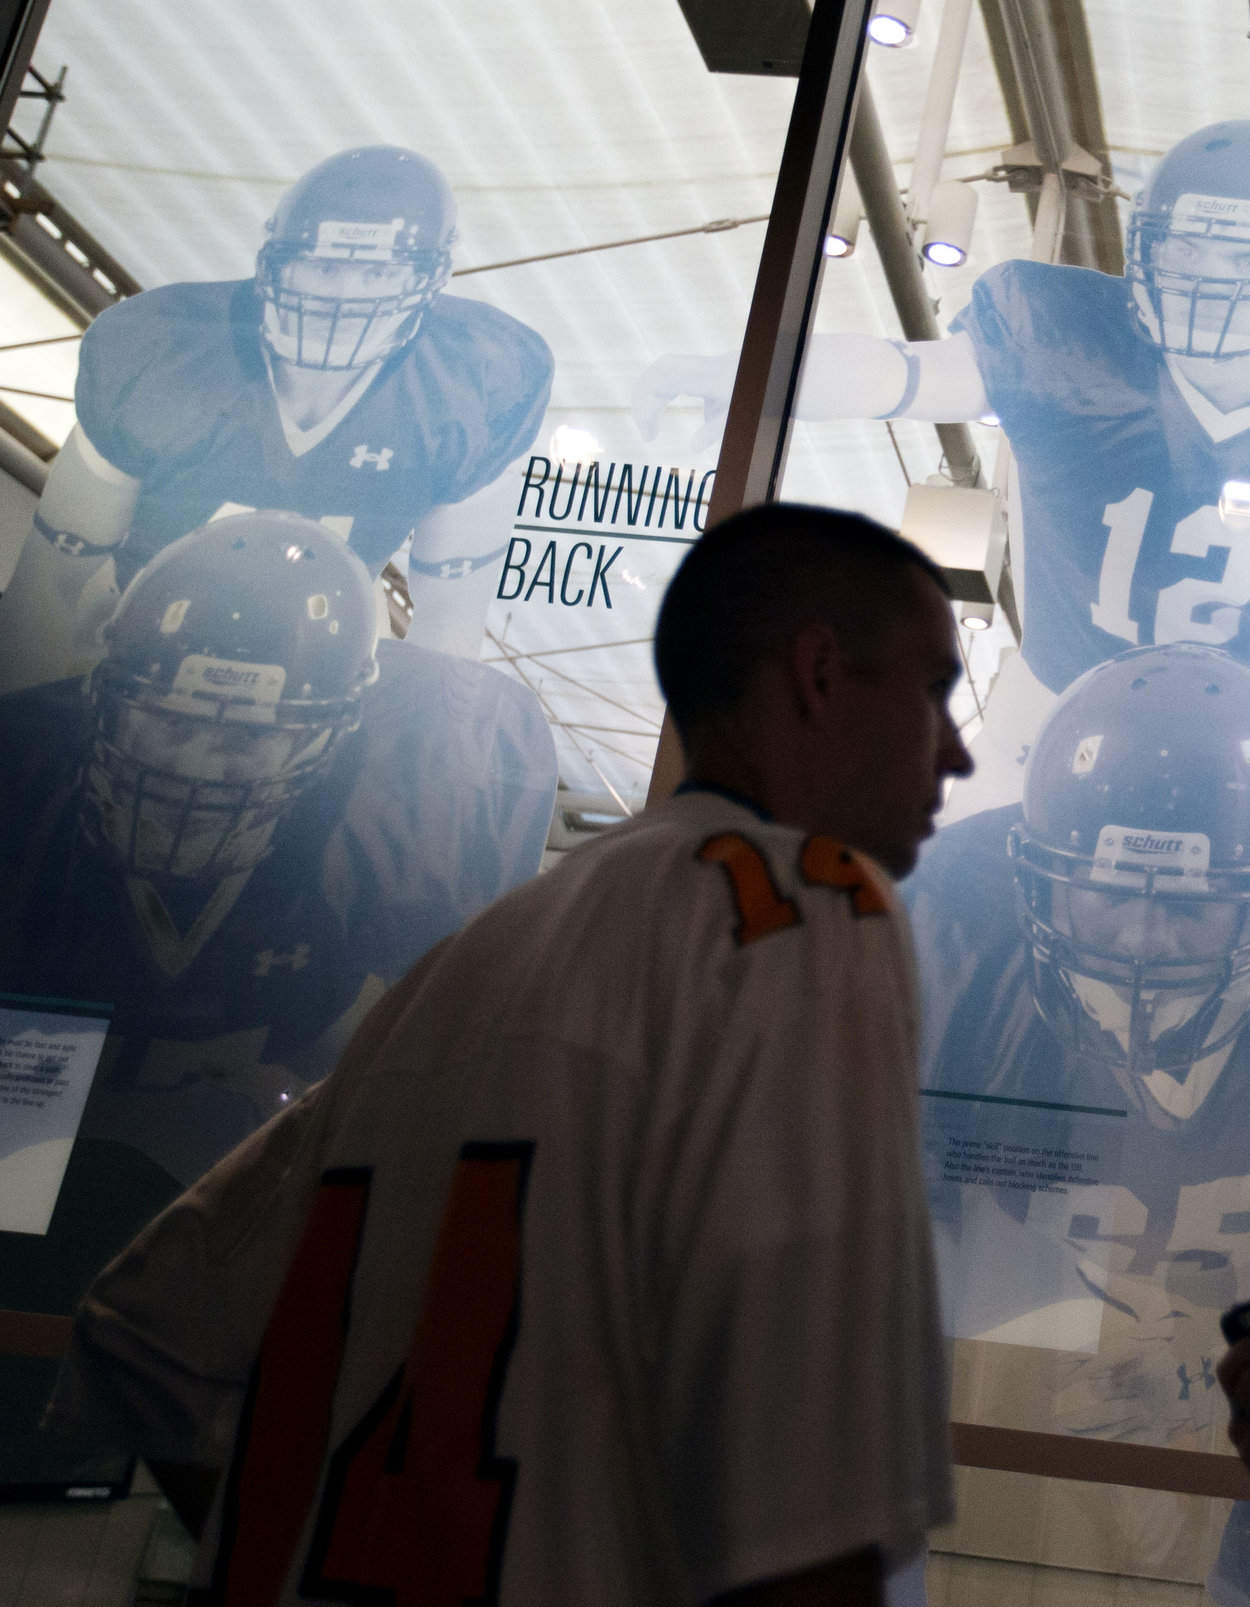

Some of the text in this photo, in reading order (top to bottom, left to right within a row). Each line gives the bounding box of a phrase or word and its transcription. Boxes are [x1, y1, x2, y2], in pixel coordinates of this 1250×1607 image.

[496, 537, 625, 610] BACK
[1122, 834, 1184, 853] schutt
[949, 1137, 961, 1146] The
[1003, 1145, 1030, 1154] position
[1054, 1150, 1085, 1160] offensive
[1087, 1153, 1098, 1161] line
[963, 1152, 989, 1161] handles
[1004, 1156, 1016, 1165] ball
[1028, 1159, 1046, 1168] much
[1058, 1162, 1069, 1170] the
[944, 1161, 960, 1170] Also
[961, 1163, 972, 1171] the
[1067, 1176, 1099, 1185] defensive
[964, 1176, 977, 1184] and
[1008, 1181, 1036, 1192] blocking
[209, 1138, 539, 1607] 14
